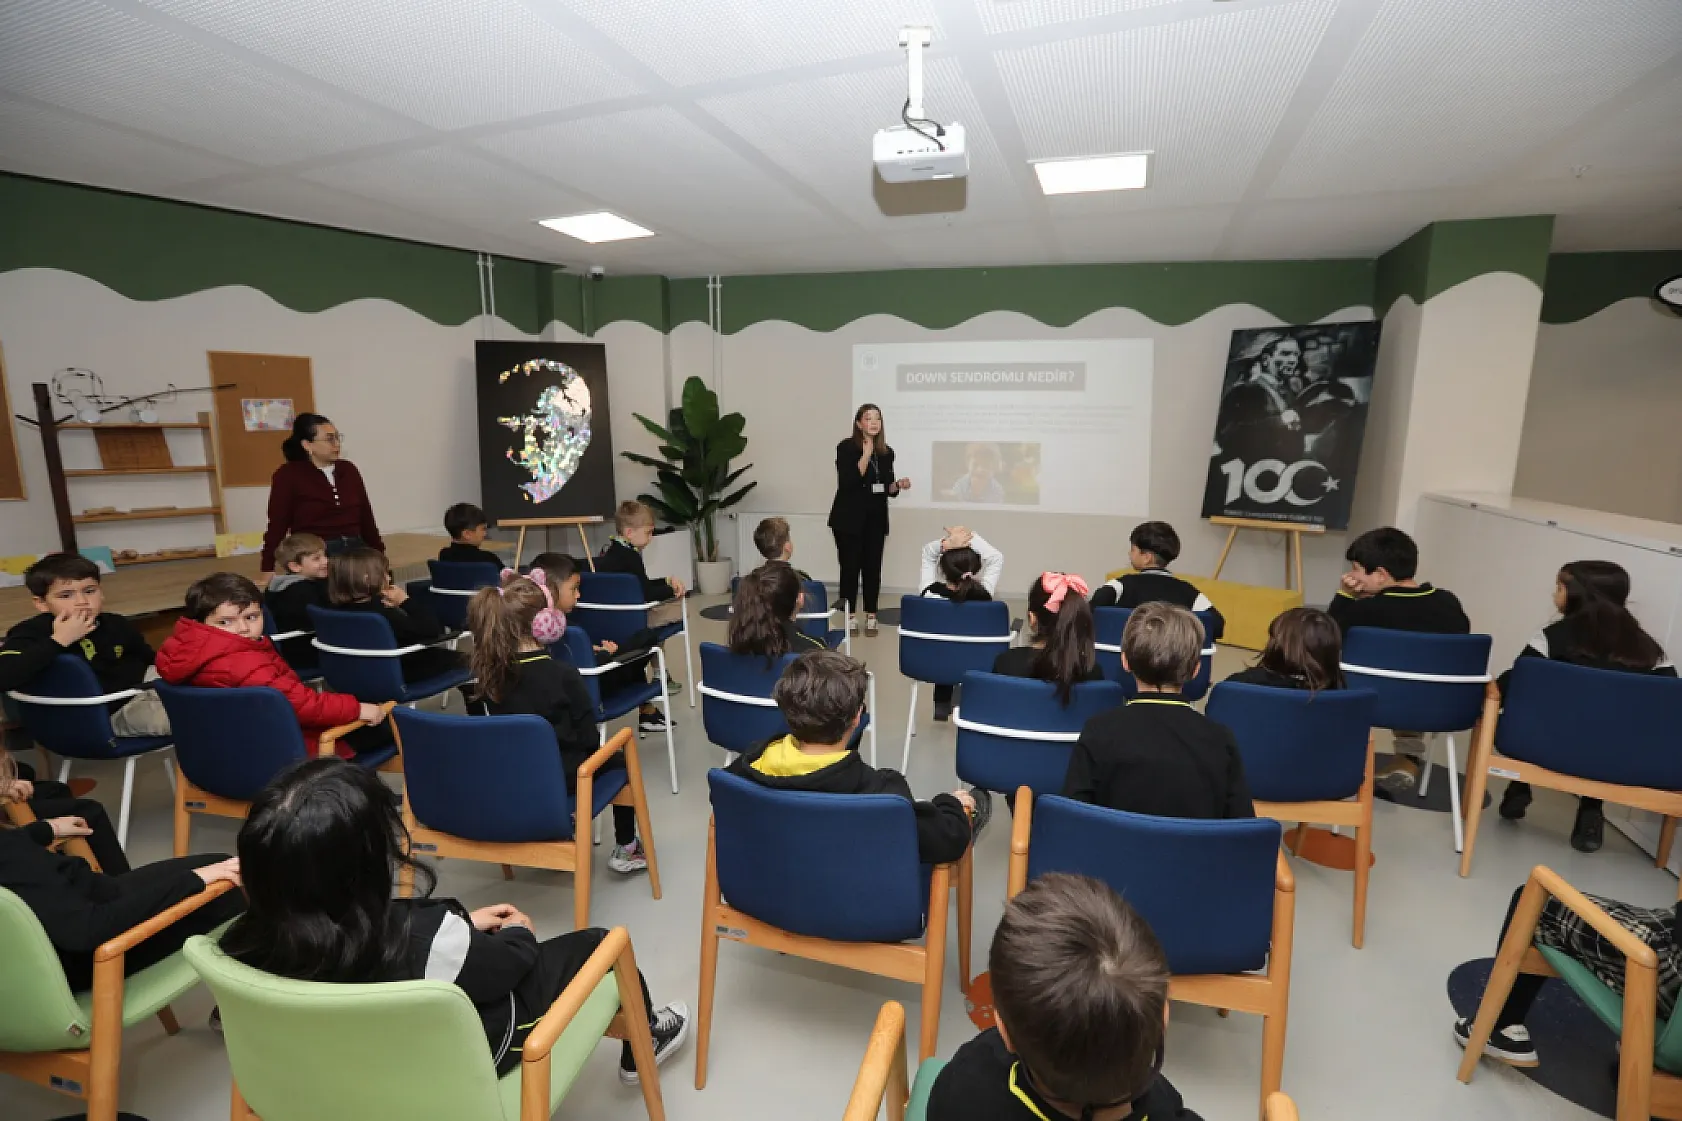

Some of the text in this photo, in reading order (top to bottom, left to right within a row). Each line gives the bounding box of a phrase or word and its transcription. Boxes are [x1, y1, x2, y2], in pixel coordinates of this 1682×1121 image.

[906, 369, 1075, 383] DOWN SENDROMU NEDİR?
